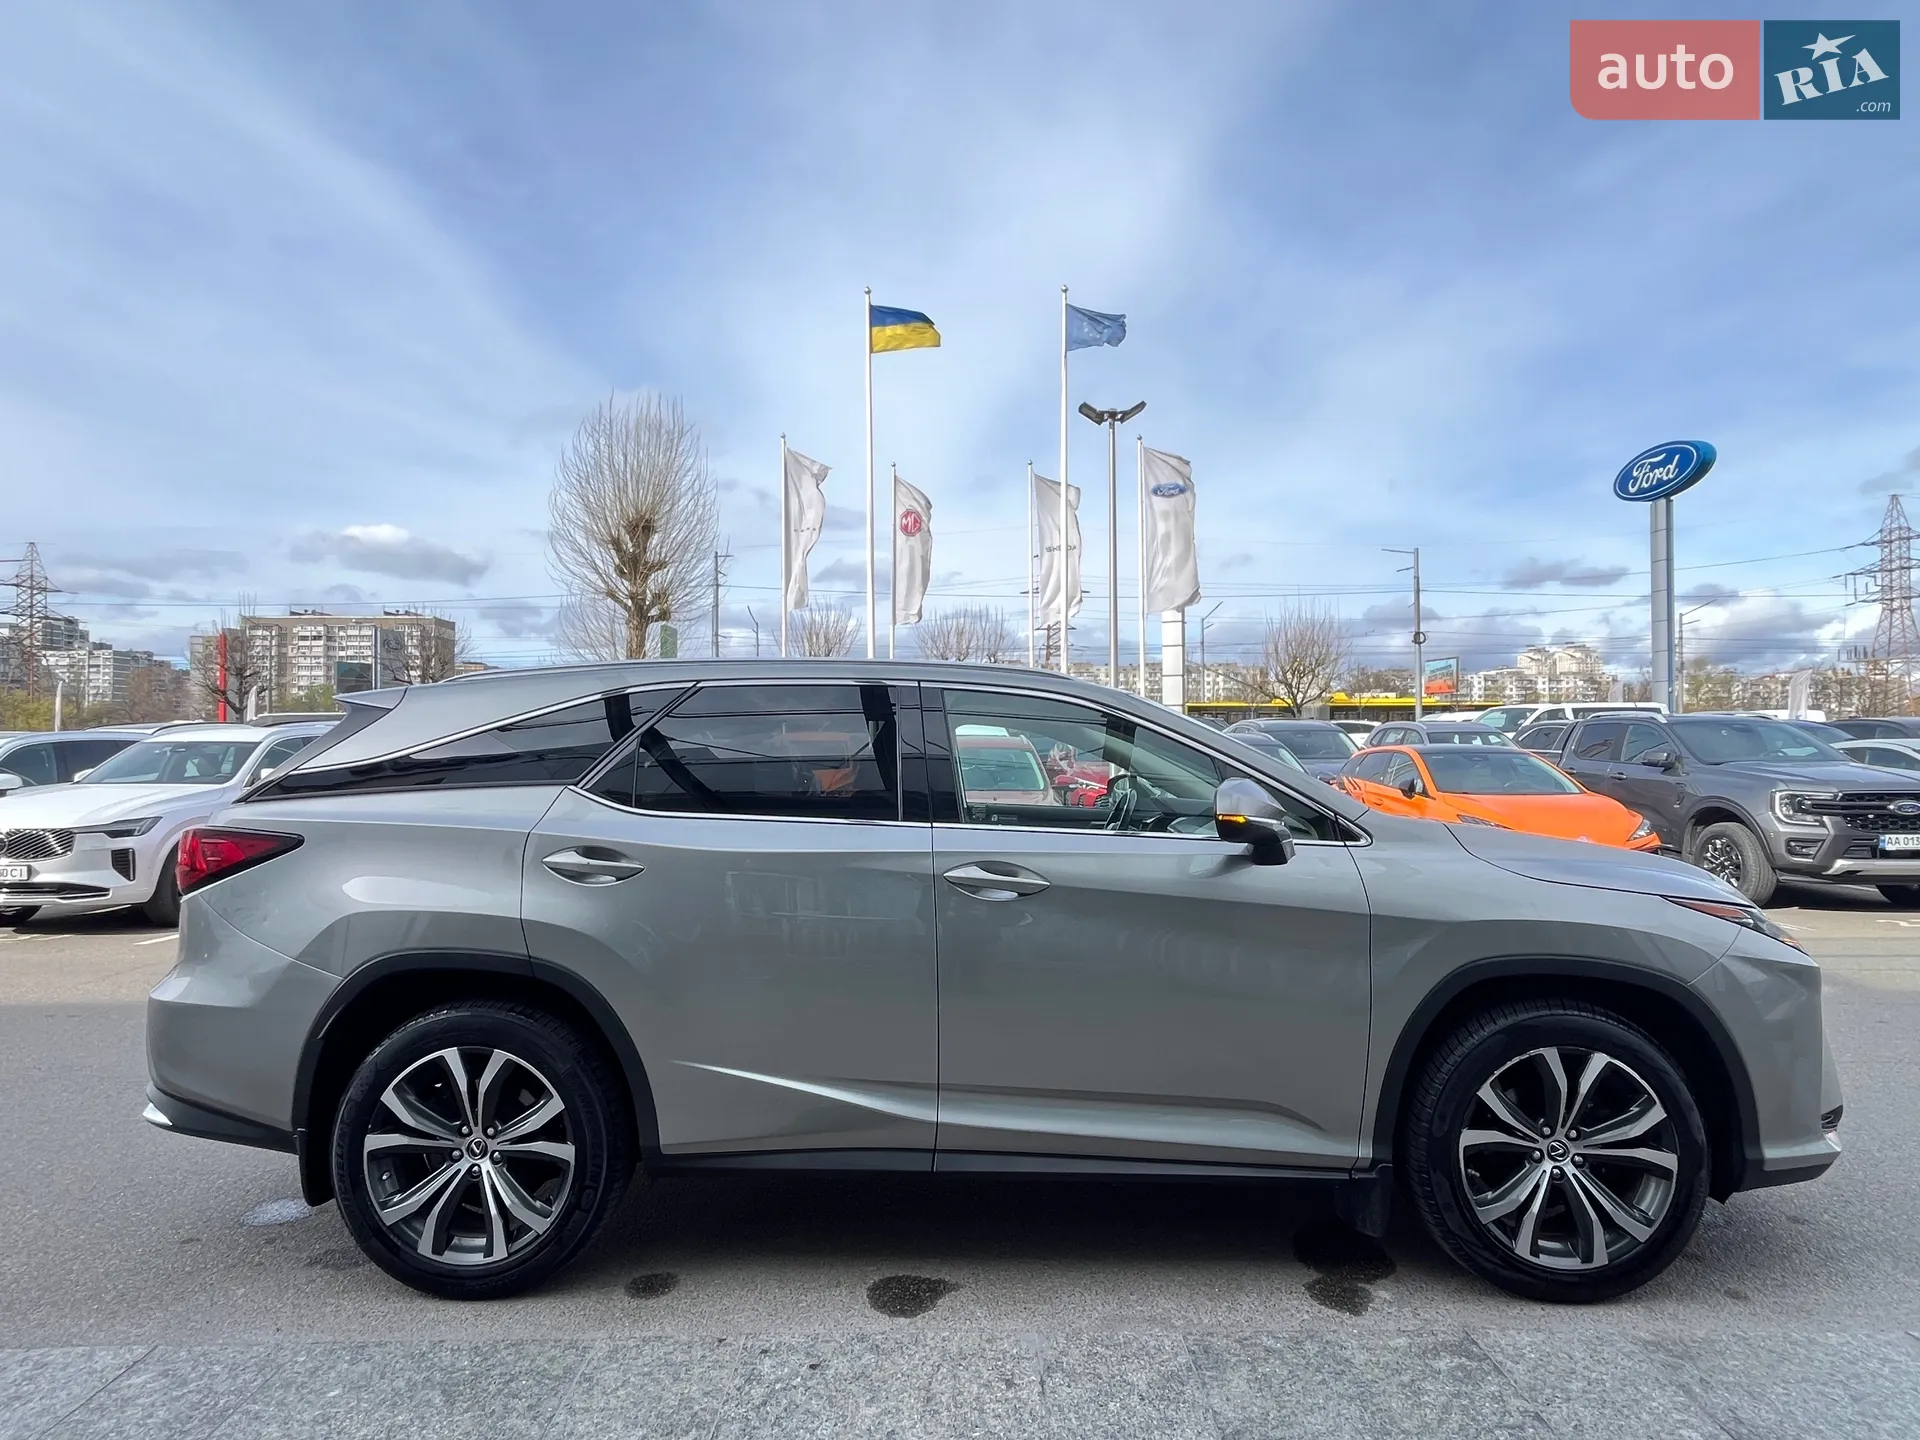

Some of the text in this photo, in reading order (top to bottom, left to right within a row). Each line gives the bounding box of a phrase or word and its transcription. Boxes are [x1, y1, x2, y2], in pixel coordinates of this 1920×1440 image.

[1628, 453, 1680, 493] Ford
[1157, 485, 1180, 496] Ford
[902, 511, 921, 534] MG
[1887, 836, 1900, 846] AA
